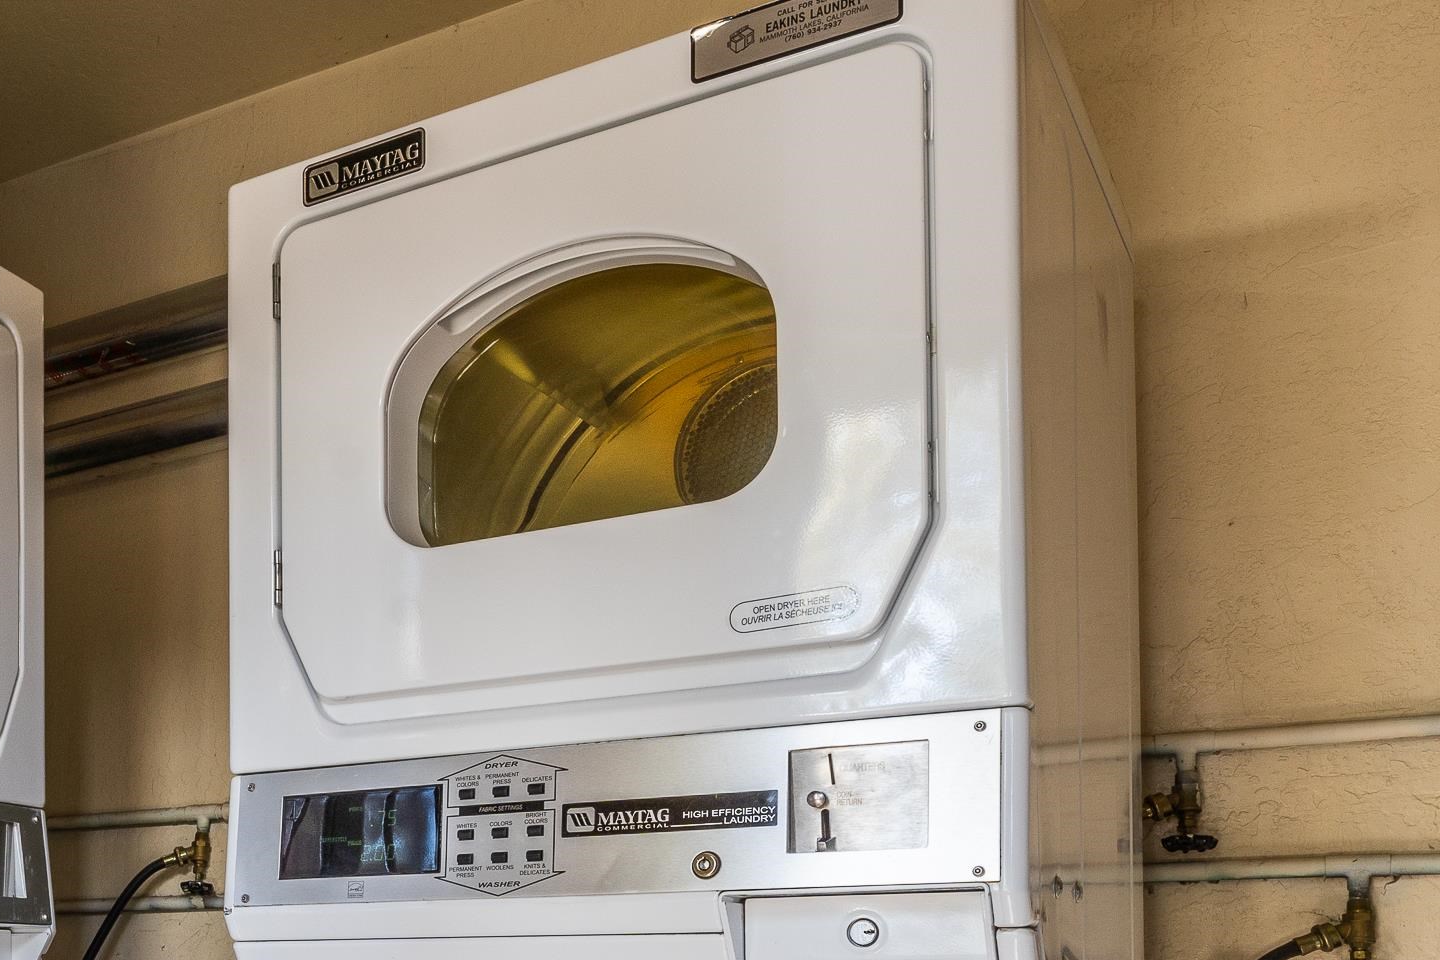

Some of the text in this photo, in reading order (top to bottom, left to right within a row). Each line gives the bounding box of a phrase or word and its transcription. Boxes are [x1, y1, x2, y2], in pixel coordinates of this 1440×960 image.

[777, 6, 795, 17] CALL
[798, 1, 813, 10] FOR
[759, 4, 869, 43] MAMMOTH LAKES, CALIFORNIA
[765, 12, 805, 33] EAKINS
[784, 20, 842, 43] (760) 934-2937
[342, 142, 419, 182] MAYTAG
[341, 161, 418, 189] COMMERCIAL
[753, 595, 830, 614] OPEN DRYER HERE
[741, 614, 772, 626] OUVRIR
[773, 612, 783, 621] LA
[484, 761, 519, 770] DRYER
[485, 771, 519, 779] PERMANENT
[521, 775, 553, 783] DELICATES
[498, 804, 523, 812] SETTINGS
[682, 806, 776, 819] HIGH EFFICIENCY
[597, 808, 670, 826] MAYTAG
[723, 814, 776, 825] LAUNDRY
[597, 822, 669, 832] COMMERCIAL
